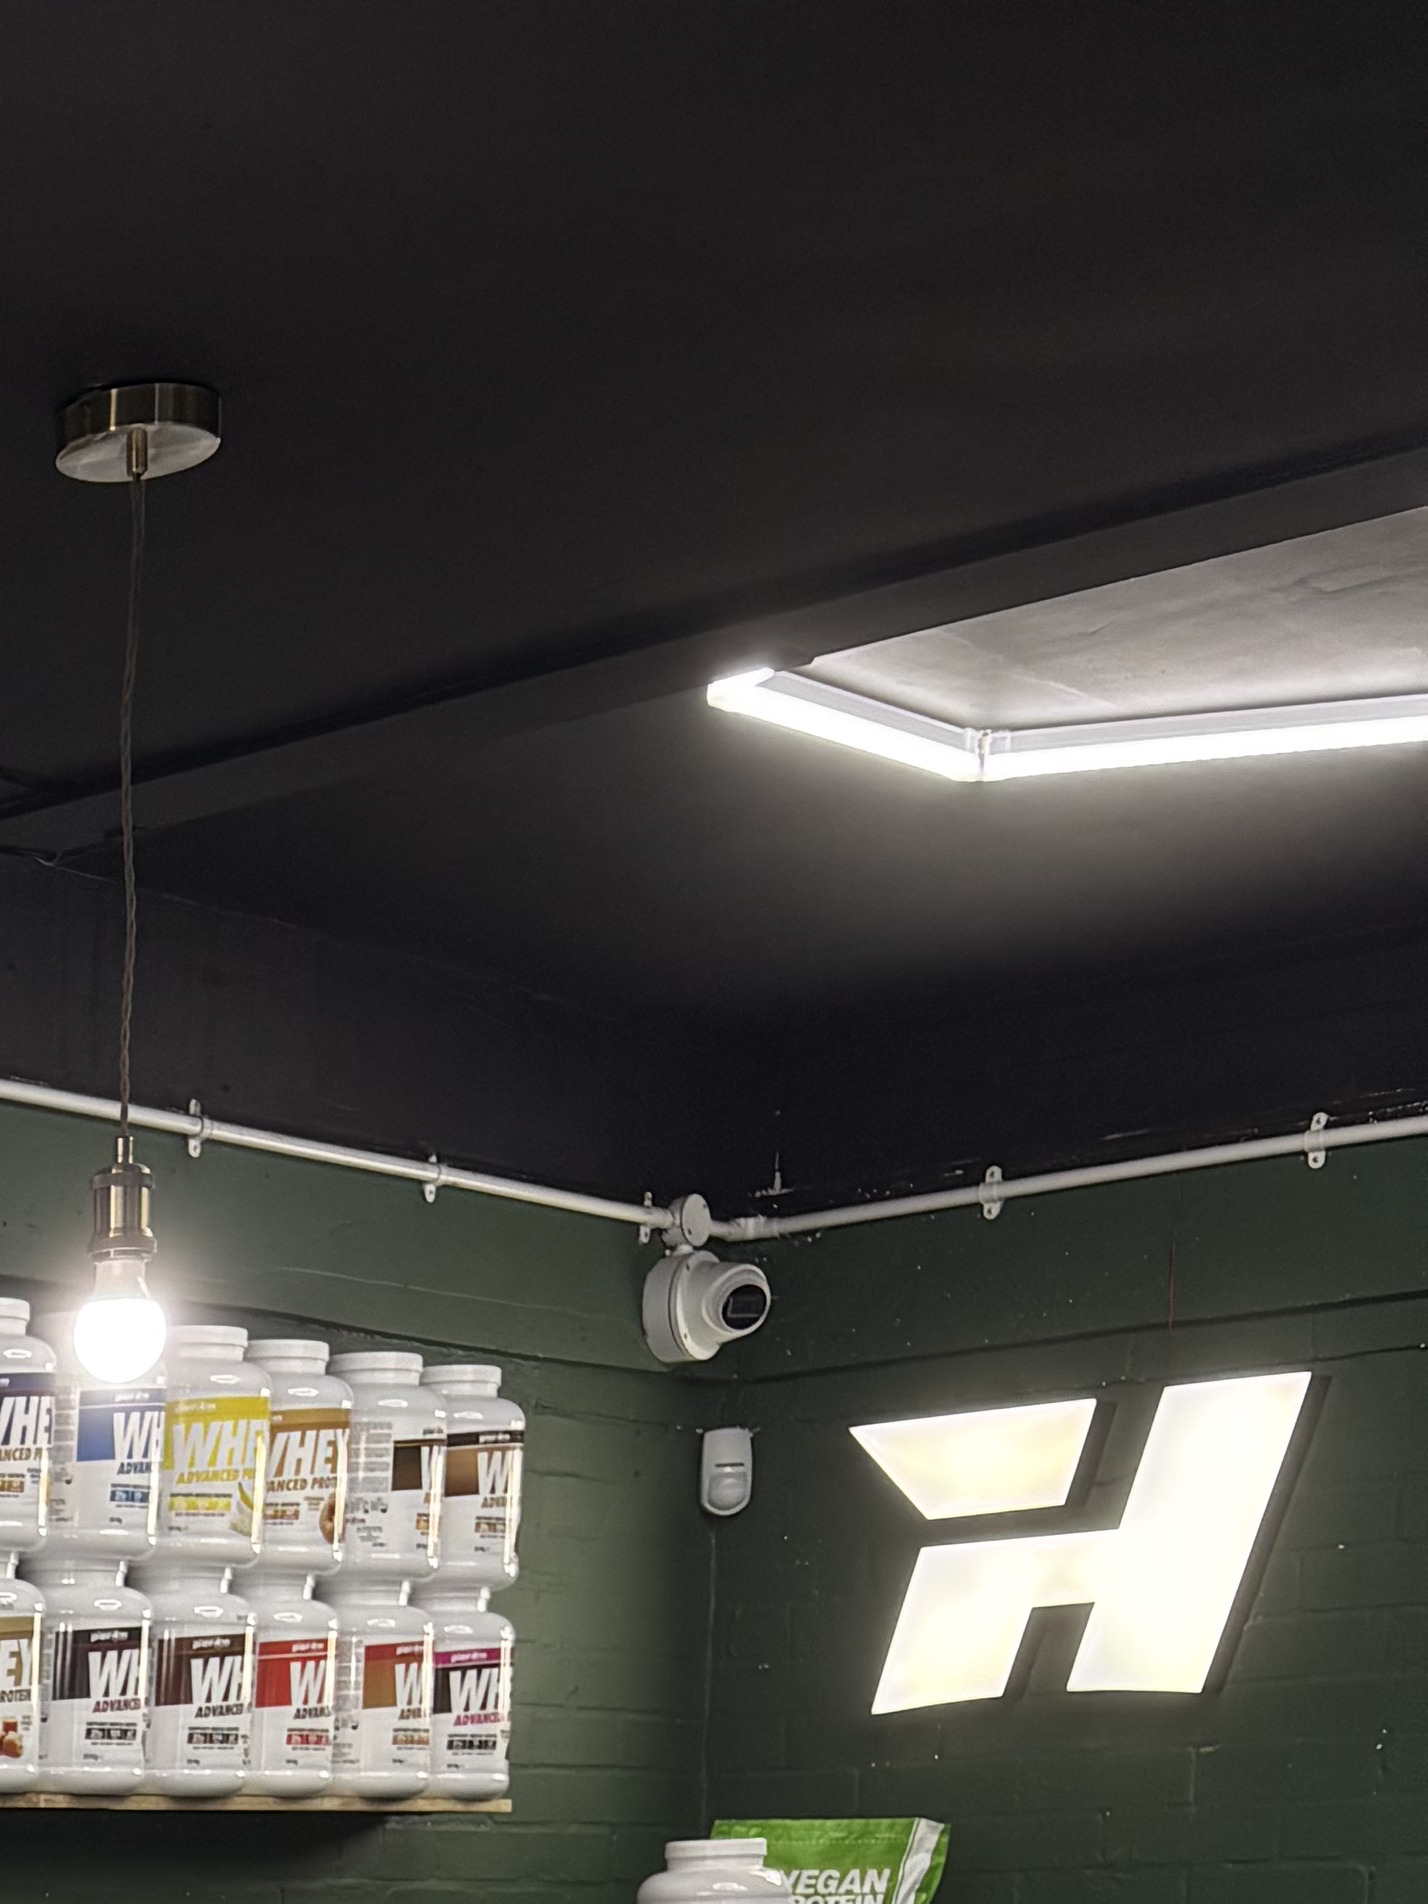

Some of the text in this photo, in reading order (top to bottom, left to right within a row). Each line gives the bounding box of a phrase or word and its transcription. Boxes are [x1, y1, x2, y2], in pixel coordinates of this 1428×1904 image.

[113, 1411, 165, 1462] WH
[172, 1418, 265, 1472] WHE
[177, 1469, 239, 1485] ADVANCED
[89, 1650, 142, 1698] WH
[191, 1656, 244, 1705] WH
[784, 1868, 892, 1894] VEGAN
